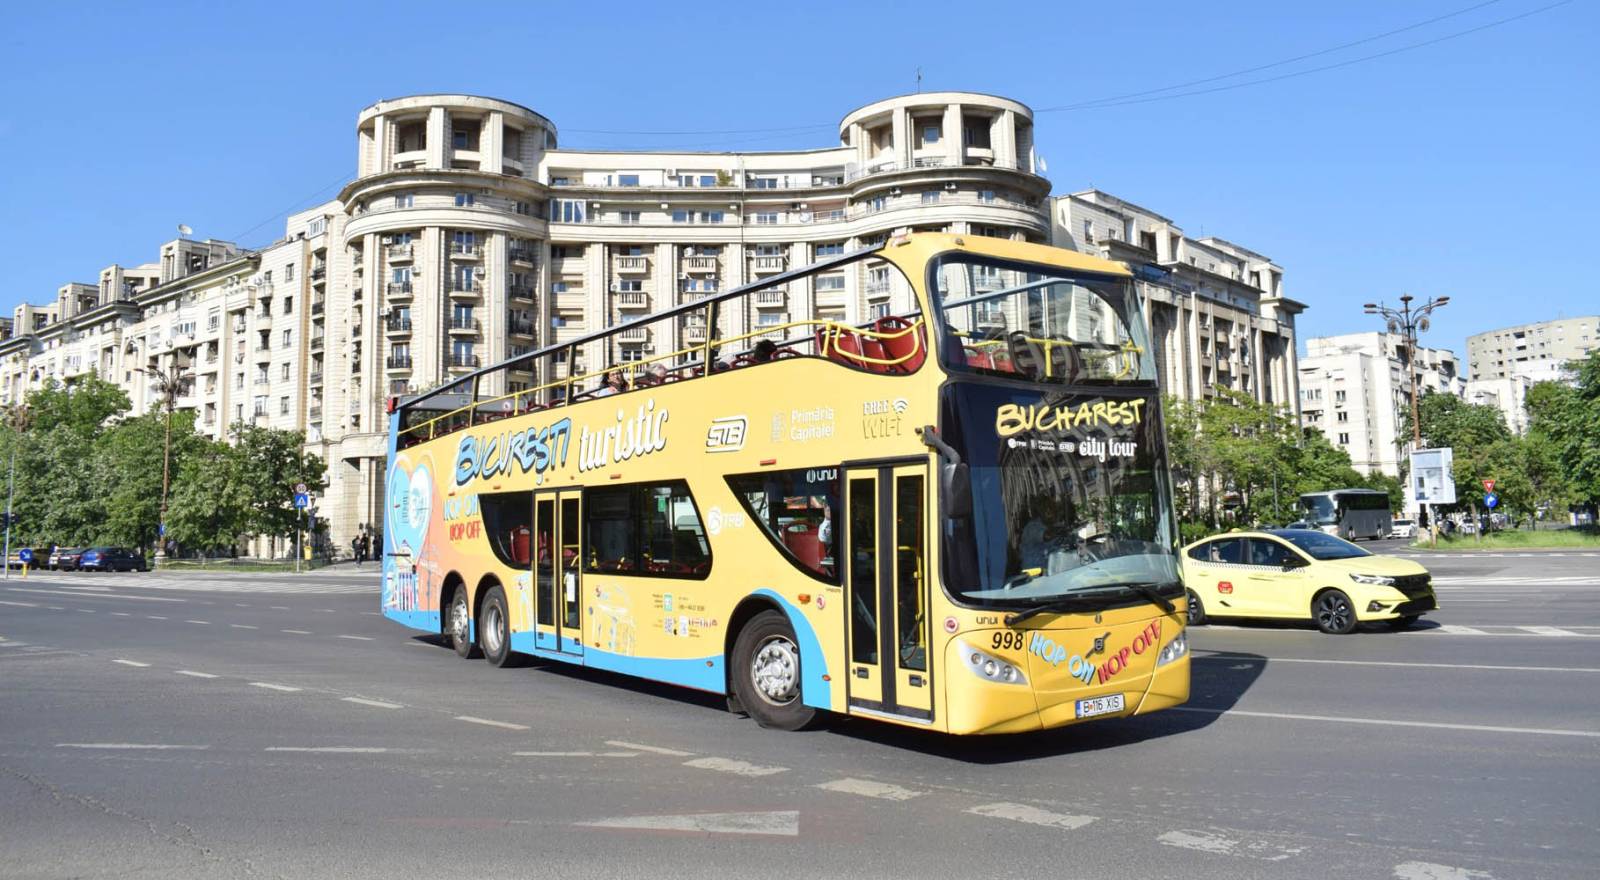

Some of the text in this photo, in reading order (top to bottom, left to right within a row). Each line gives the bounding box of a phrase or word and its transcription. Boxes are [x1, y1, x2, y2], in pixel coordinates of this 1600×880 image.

[863, 400, 889, 415] FREE
[996, 398, 1146, 437] BUCHAREST
[578, 398, 669, 473] turistic
[705, 416, 747, 451] STB
[1079, 436, 1138, 463] city tour
[466, 520, 481, 539] OFF
[991, 631, 1024, 650] 998
[1097, 618, 1162, 685] HOP OFF
[1029, 631, 1097, 686] HOP ON
